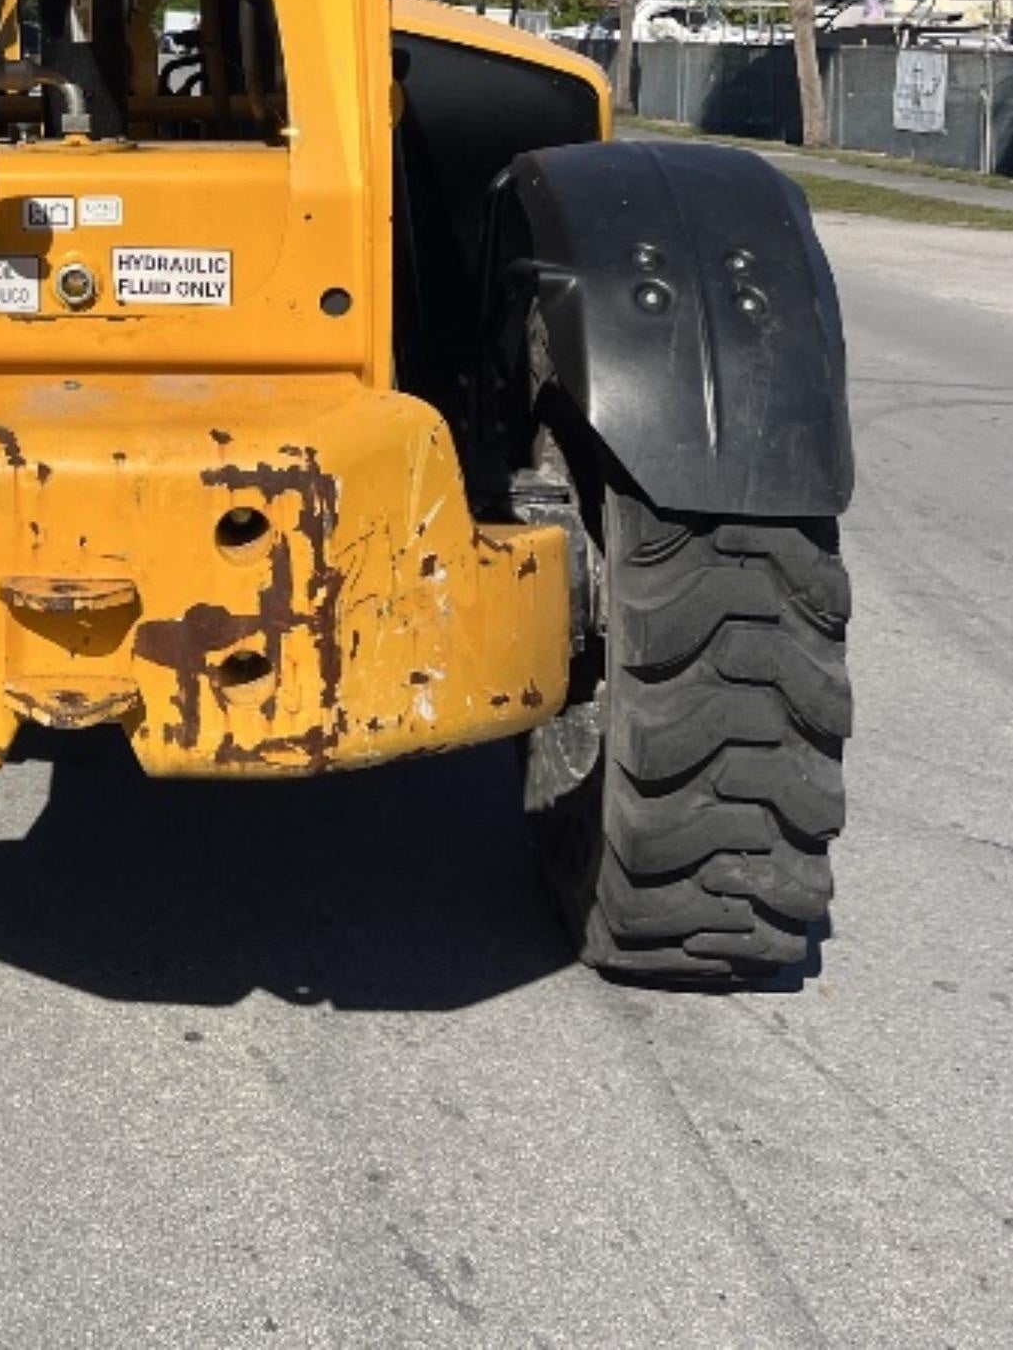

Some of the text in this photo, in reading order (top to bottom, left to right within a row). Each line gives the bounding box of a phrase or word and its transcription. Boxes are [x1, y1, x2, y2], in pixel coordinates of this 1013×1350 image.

[118, 253, 227, 274] HYDRAULIC
[118, 278, 226, 299] FLUID ONLY
